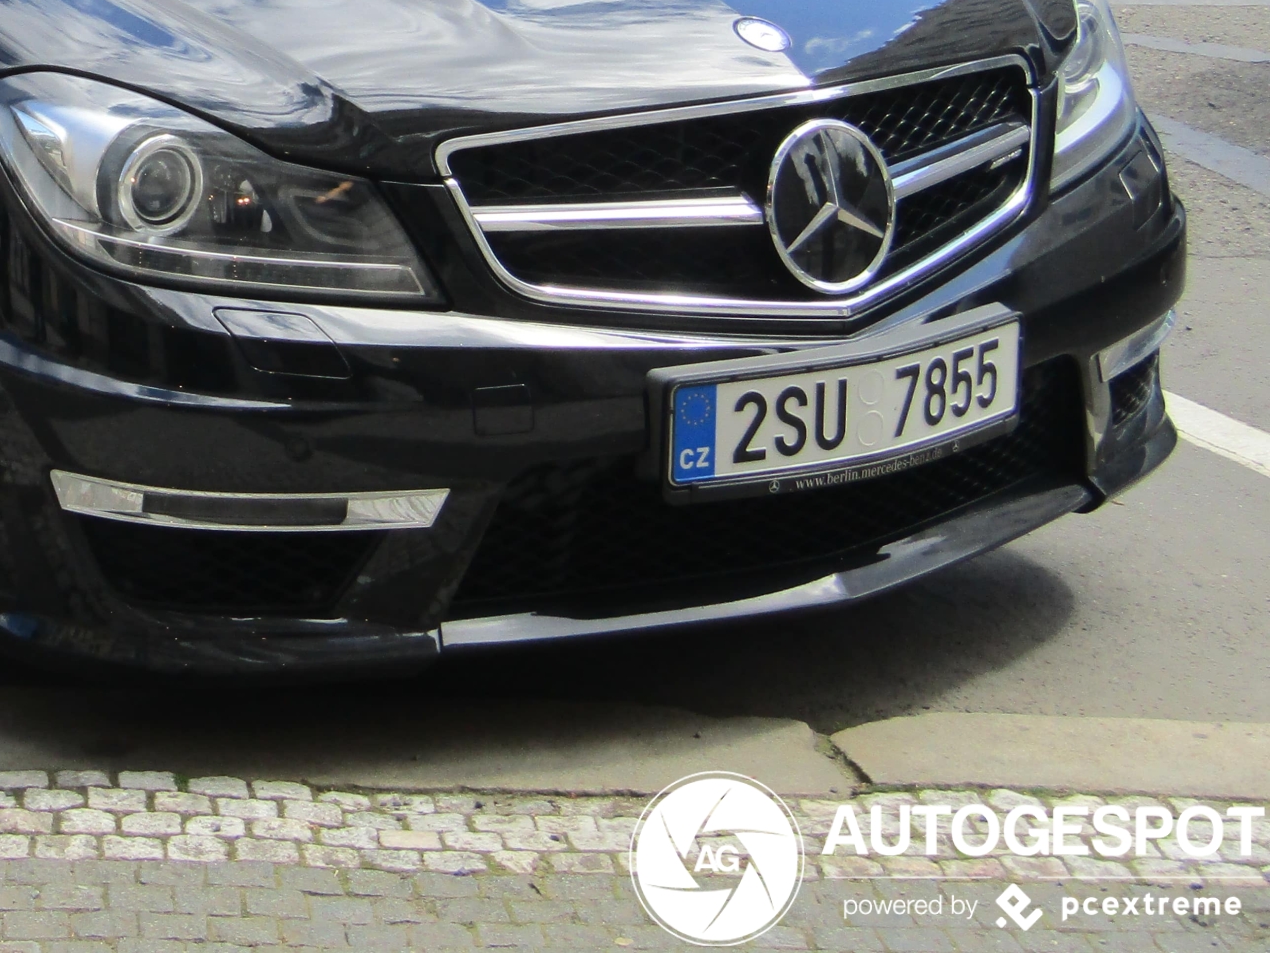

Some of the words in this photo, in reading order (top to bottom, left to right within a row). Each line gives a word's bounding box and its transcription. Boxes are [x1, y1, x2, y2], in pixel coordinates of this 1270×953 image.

[732, 378, 848, 464] 2SU
[894, 339, 1000, 438] 7855
[679, 448, 710, 470] CZ
[795, 447, 943, 490] www.berlin.mercedes-benz.de
